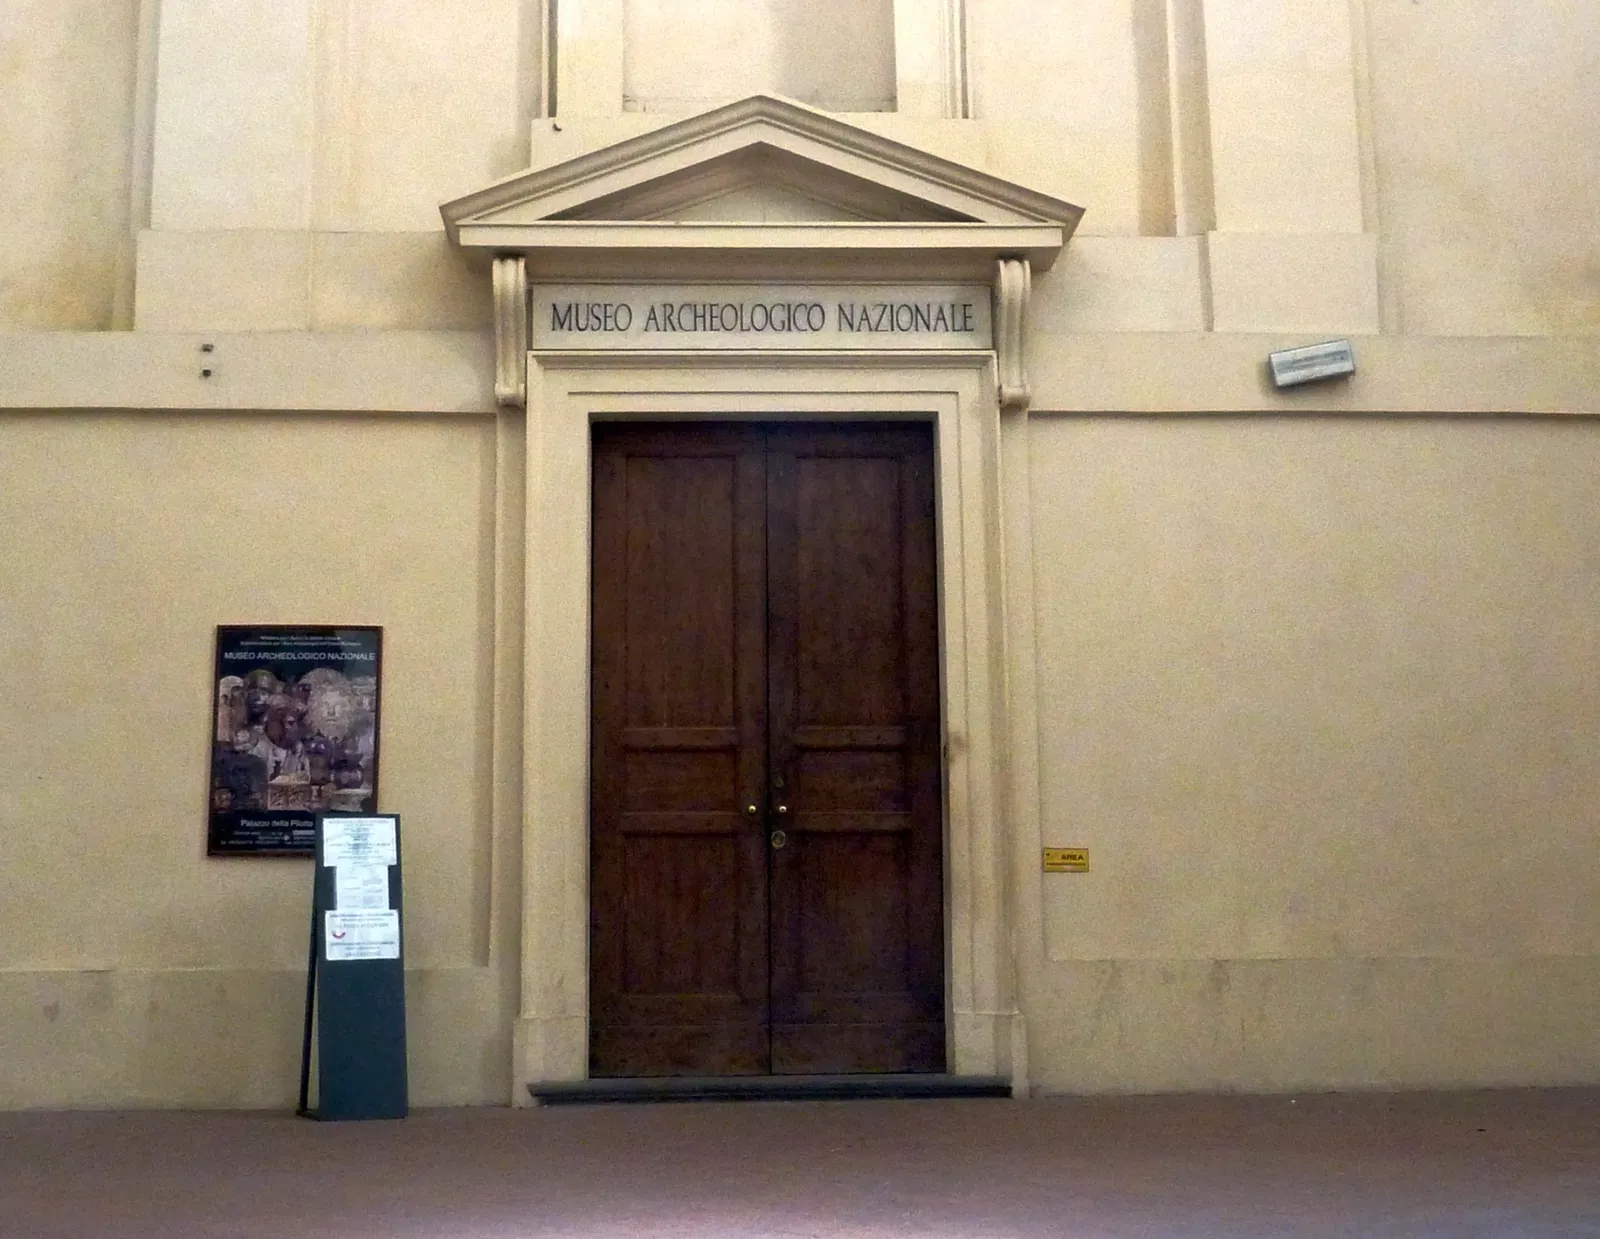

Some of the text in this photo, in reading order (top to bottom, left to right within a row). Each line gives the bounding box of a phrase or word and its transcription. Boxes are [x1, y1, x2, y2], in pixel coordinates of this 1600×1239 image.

[551, 303, 974, 332] MUSEO ARCHEOLOGICO NAZIONALE
[224, 652, 375, 661] MUSEO ARCHEOLOGICO NAZIONALE
